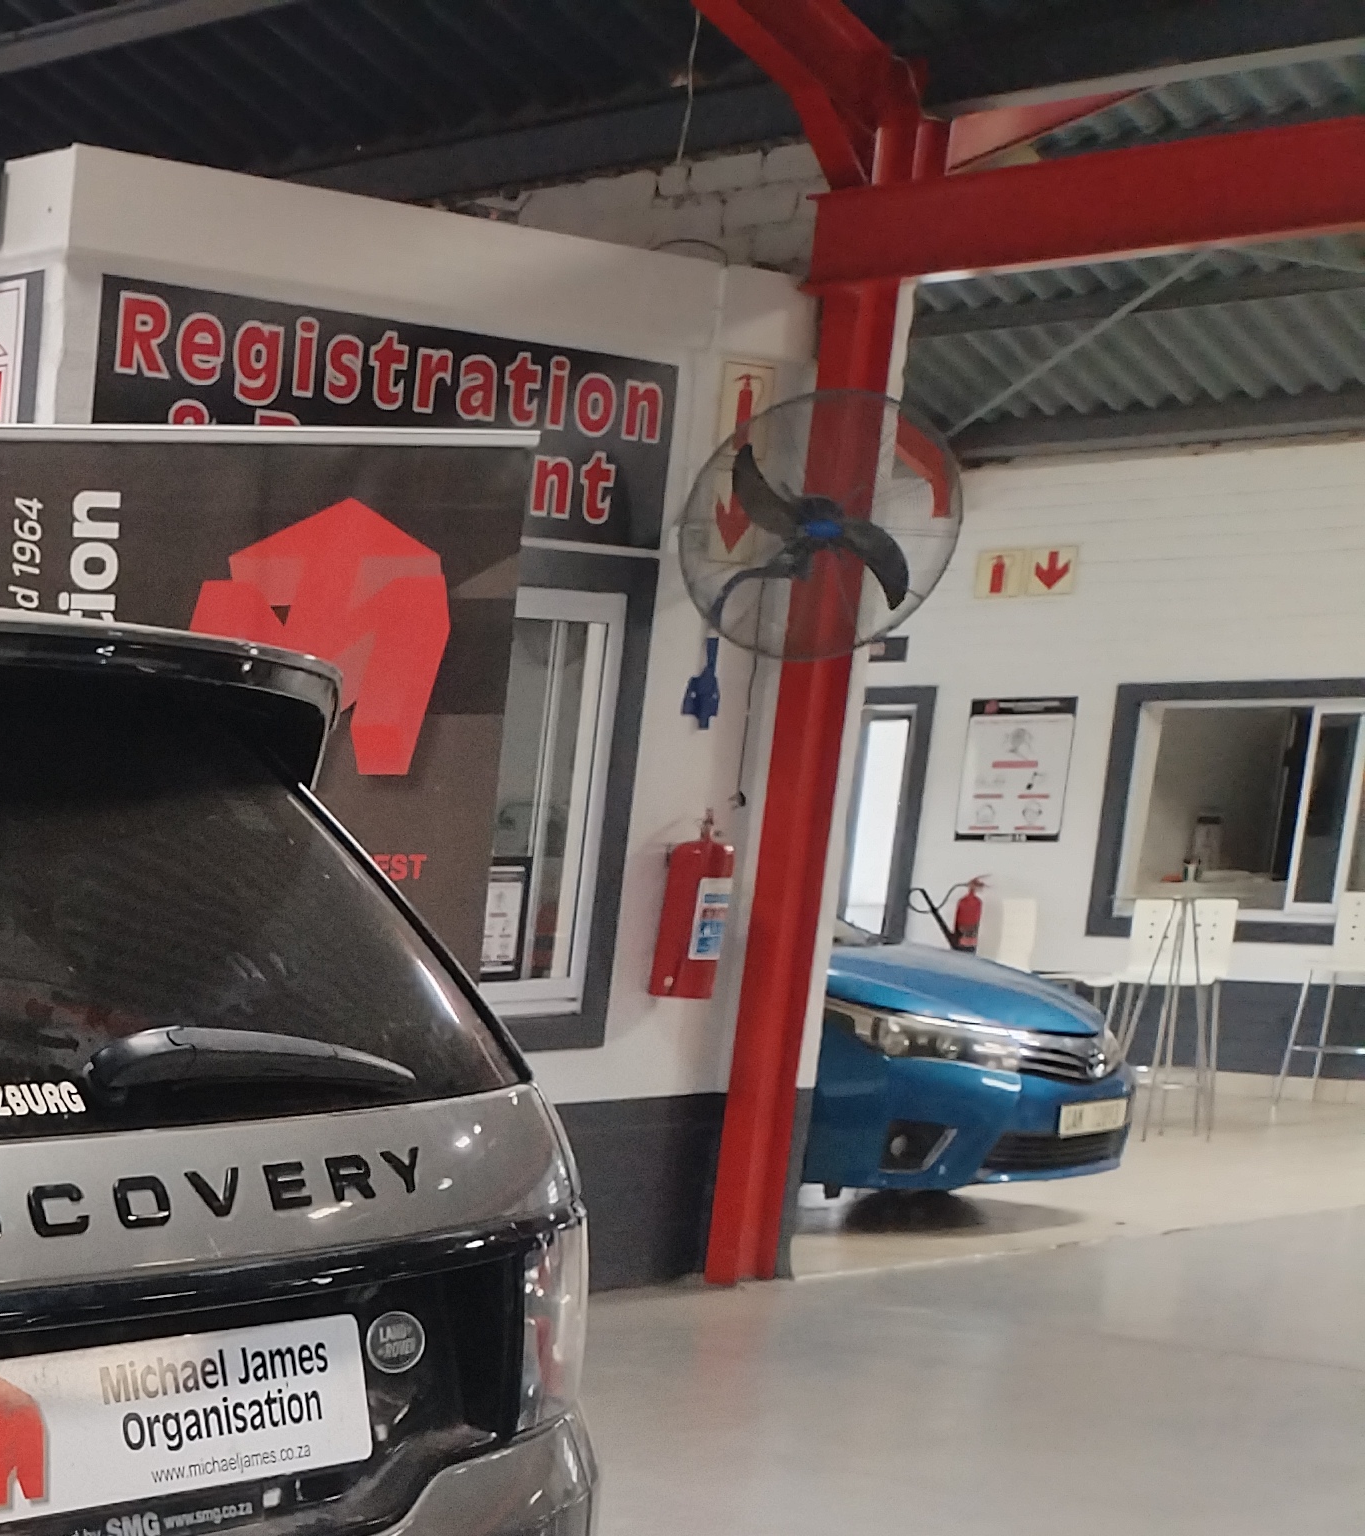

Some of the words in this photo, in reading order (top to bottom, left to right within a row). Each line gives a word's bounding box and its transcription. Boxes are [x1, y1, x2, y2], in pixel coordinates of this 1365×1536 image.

[114, 291, 662, 443] Registration
[11, 497, 44, 576] 1964
[100, 1349, 228, 1405] Michael
[238, 1340, 329, 1385] James
[122, 1389, 323, 1452] Organisation
[151, 1445, 312, 1485] www.michaeljames.co.za
